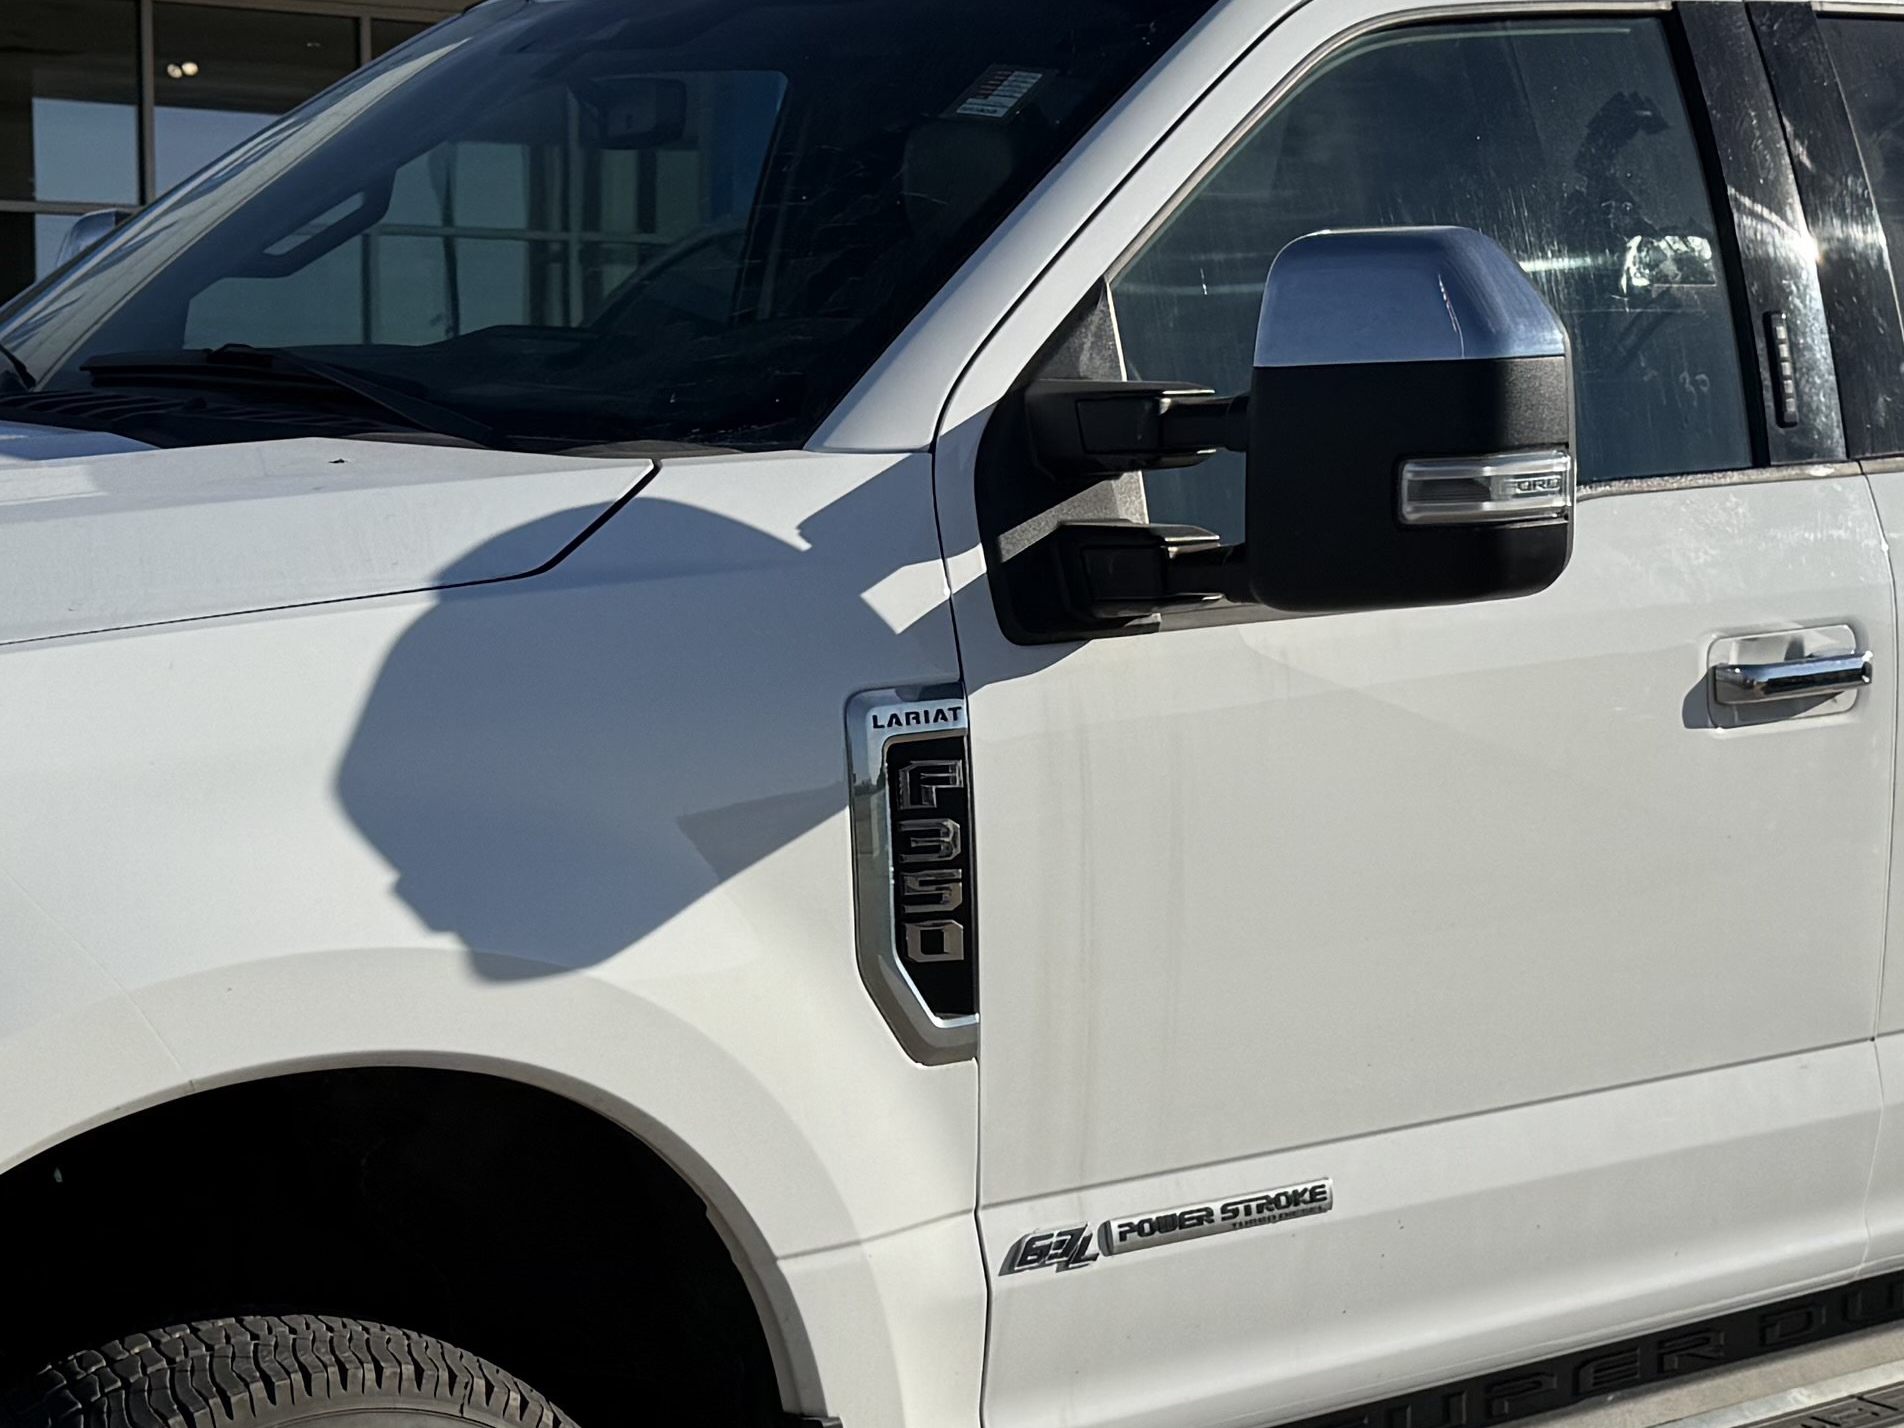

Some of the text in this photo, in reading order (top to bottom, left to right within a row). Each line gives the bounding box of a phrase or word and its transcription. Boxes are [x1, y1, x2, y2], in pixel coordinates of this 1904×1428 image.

[871, 705, 964, 730] LARIAT
[1117, 1205, 1215, 1244] POWER
[1220, 1183, 1329, 1222] STROKE
